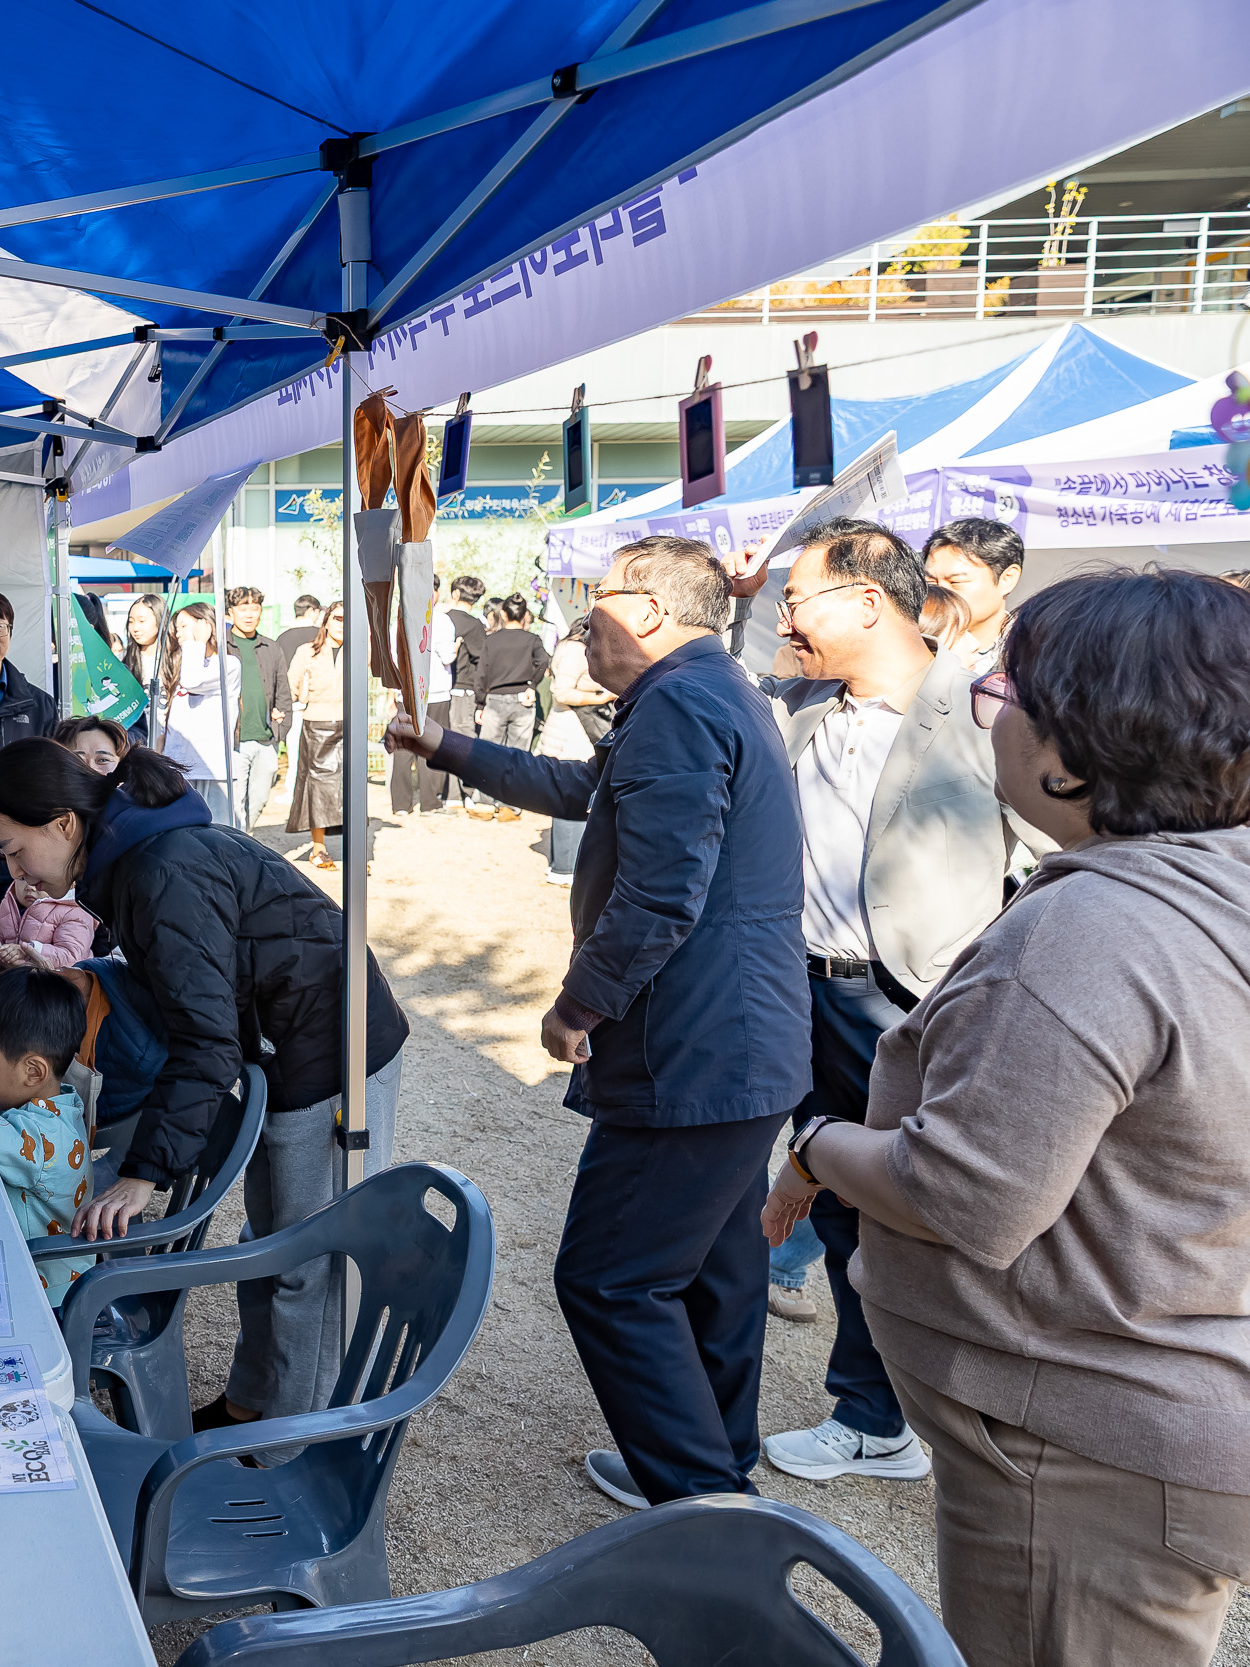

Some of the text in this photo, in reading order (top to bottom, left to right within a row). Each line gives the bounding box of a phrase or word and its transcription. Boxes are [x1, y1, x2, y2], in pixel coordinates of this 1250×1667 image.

[1128, 467, 1210, 494] 피어나는
[1055, 497, 1250, 529] 청소년 가죽공예 체험프로
[32, 1440, 51, 1456] BAG
[11, 1473, 27, 1483] MY
[22, 1449, 51, 1484] ECO
